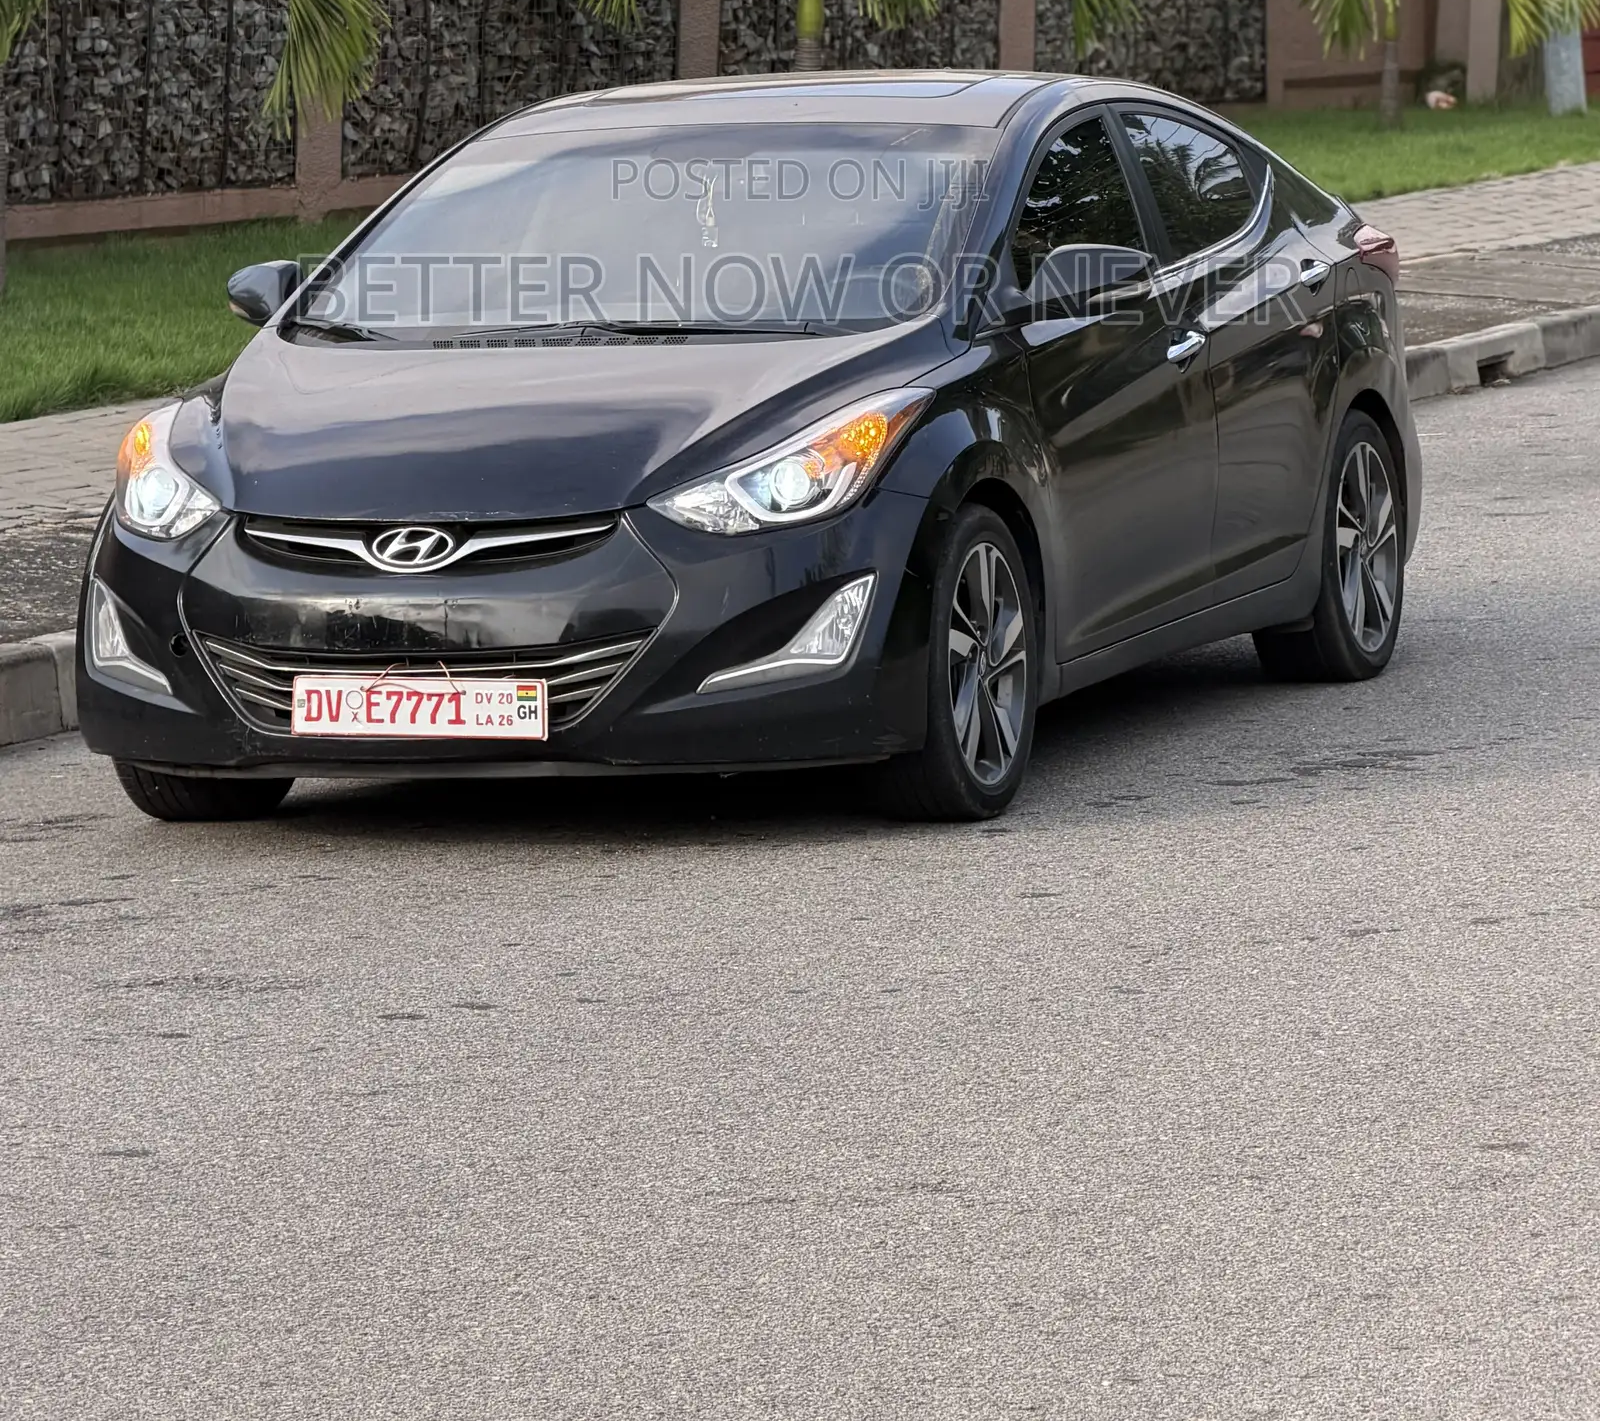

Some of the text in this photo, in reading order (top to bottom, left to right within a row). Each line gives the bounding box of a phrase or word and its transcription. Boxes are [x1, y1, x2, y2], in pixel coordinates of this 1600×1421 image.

[475, 692, 513, 704] DV 20
[304, 689, 467, 725] DV E7771
[516, 704, 538, 720] GH
[476, 713, 513, 726] LA 26
